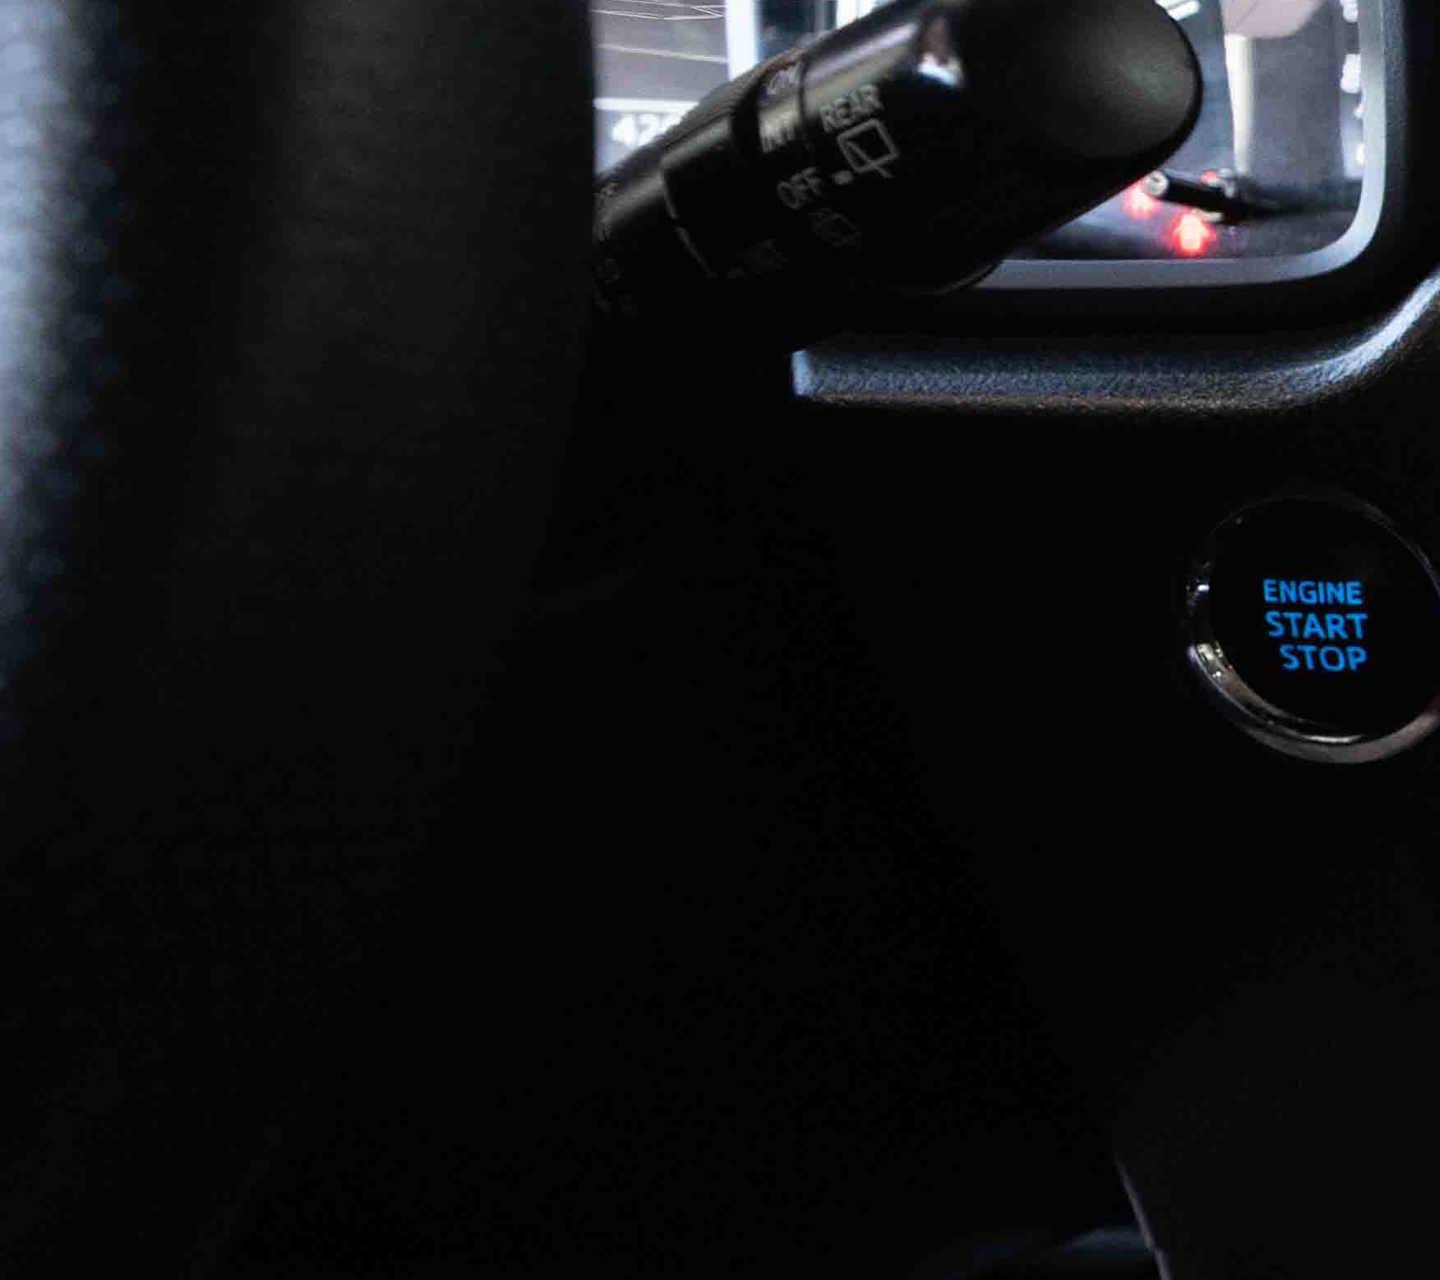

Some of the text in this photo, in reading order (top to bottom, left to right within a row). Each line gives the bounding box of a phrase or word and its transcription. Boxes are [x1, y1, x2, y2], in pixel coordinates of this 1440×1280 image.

[819, 82, 885, 134] REAR
[1263, 579, 1362, 606] ENGINE
[1265, 610, 1368, 641] START
[1280, 643, 1367, 672] STOP
